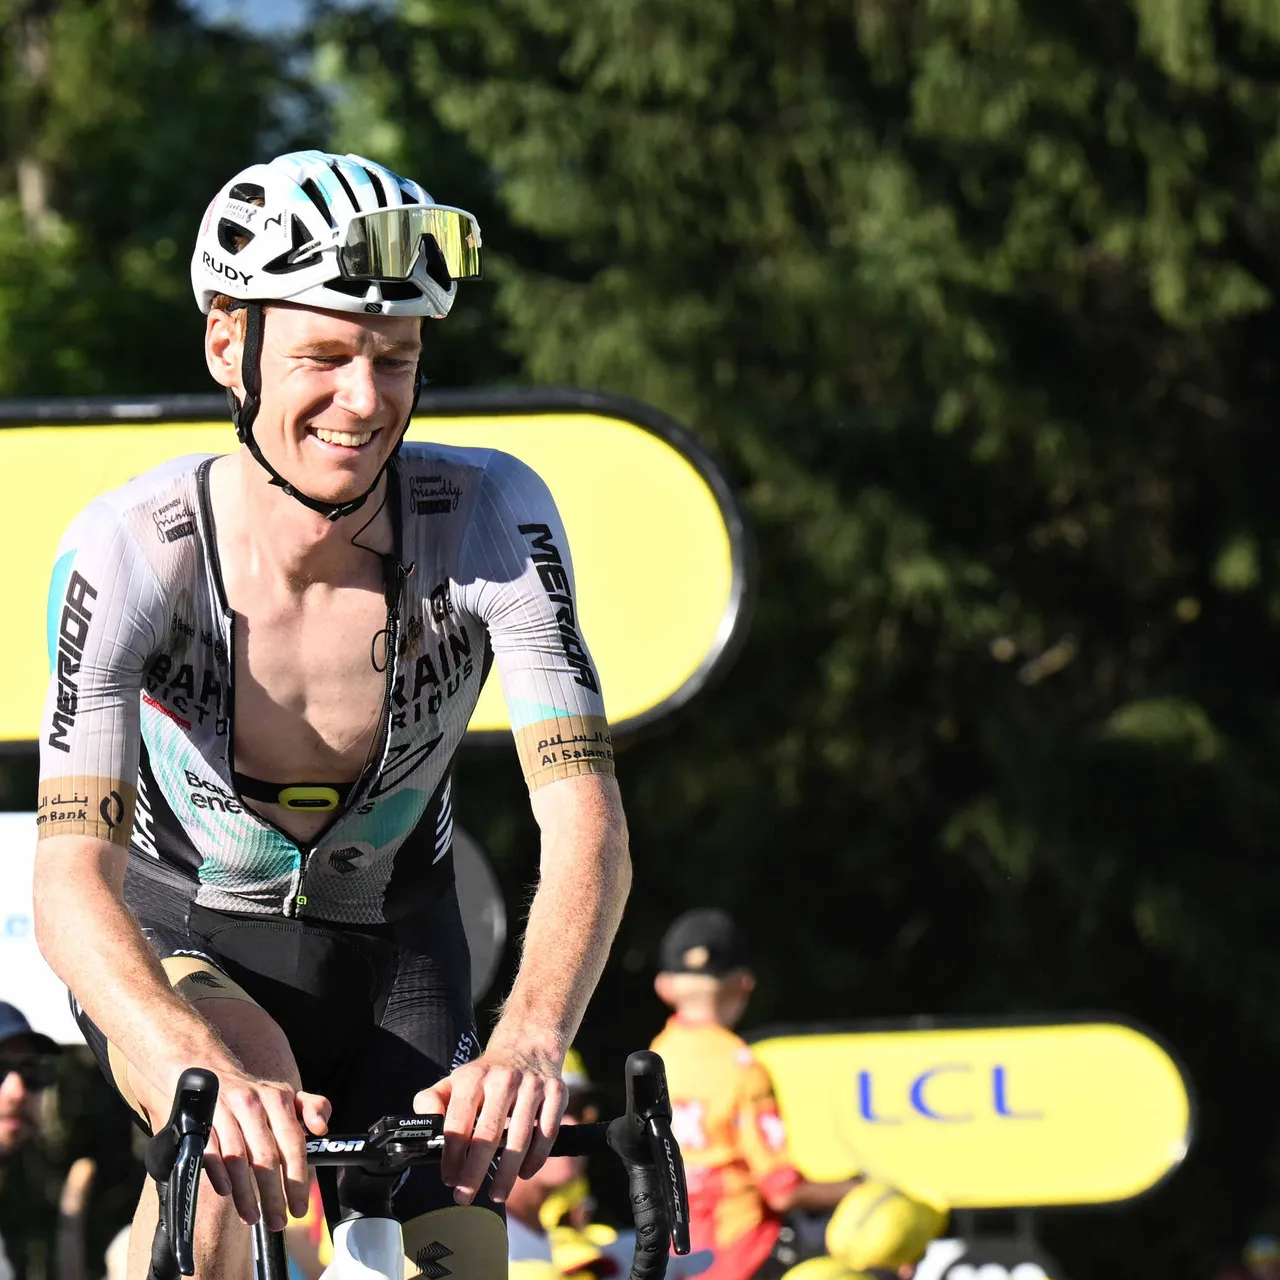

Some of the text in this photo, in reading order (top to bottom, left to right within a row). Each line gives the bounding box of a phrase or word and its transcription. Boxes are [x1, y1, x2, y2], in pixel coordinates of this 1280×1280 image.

[202, 251, 254, 286] RUDY
[410, 476, 463, 514] friendly
[517, 523, 599, 694] MERIDA
[48, 570, 98, 753] MERIDA
[541, 752, 558, 766] Al
[562, 748, 607, 761] Salam
[50, 809, 88, 821] Bank
[857, 1064, 1045, 1125] LCL
[399, 1119, 434, 1127] GARMIN
[183, 1155, 196, 1244] DURA-ACE
[663, 1138, 684, 1224] DURA-ACE
